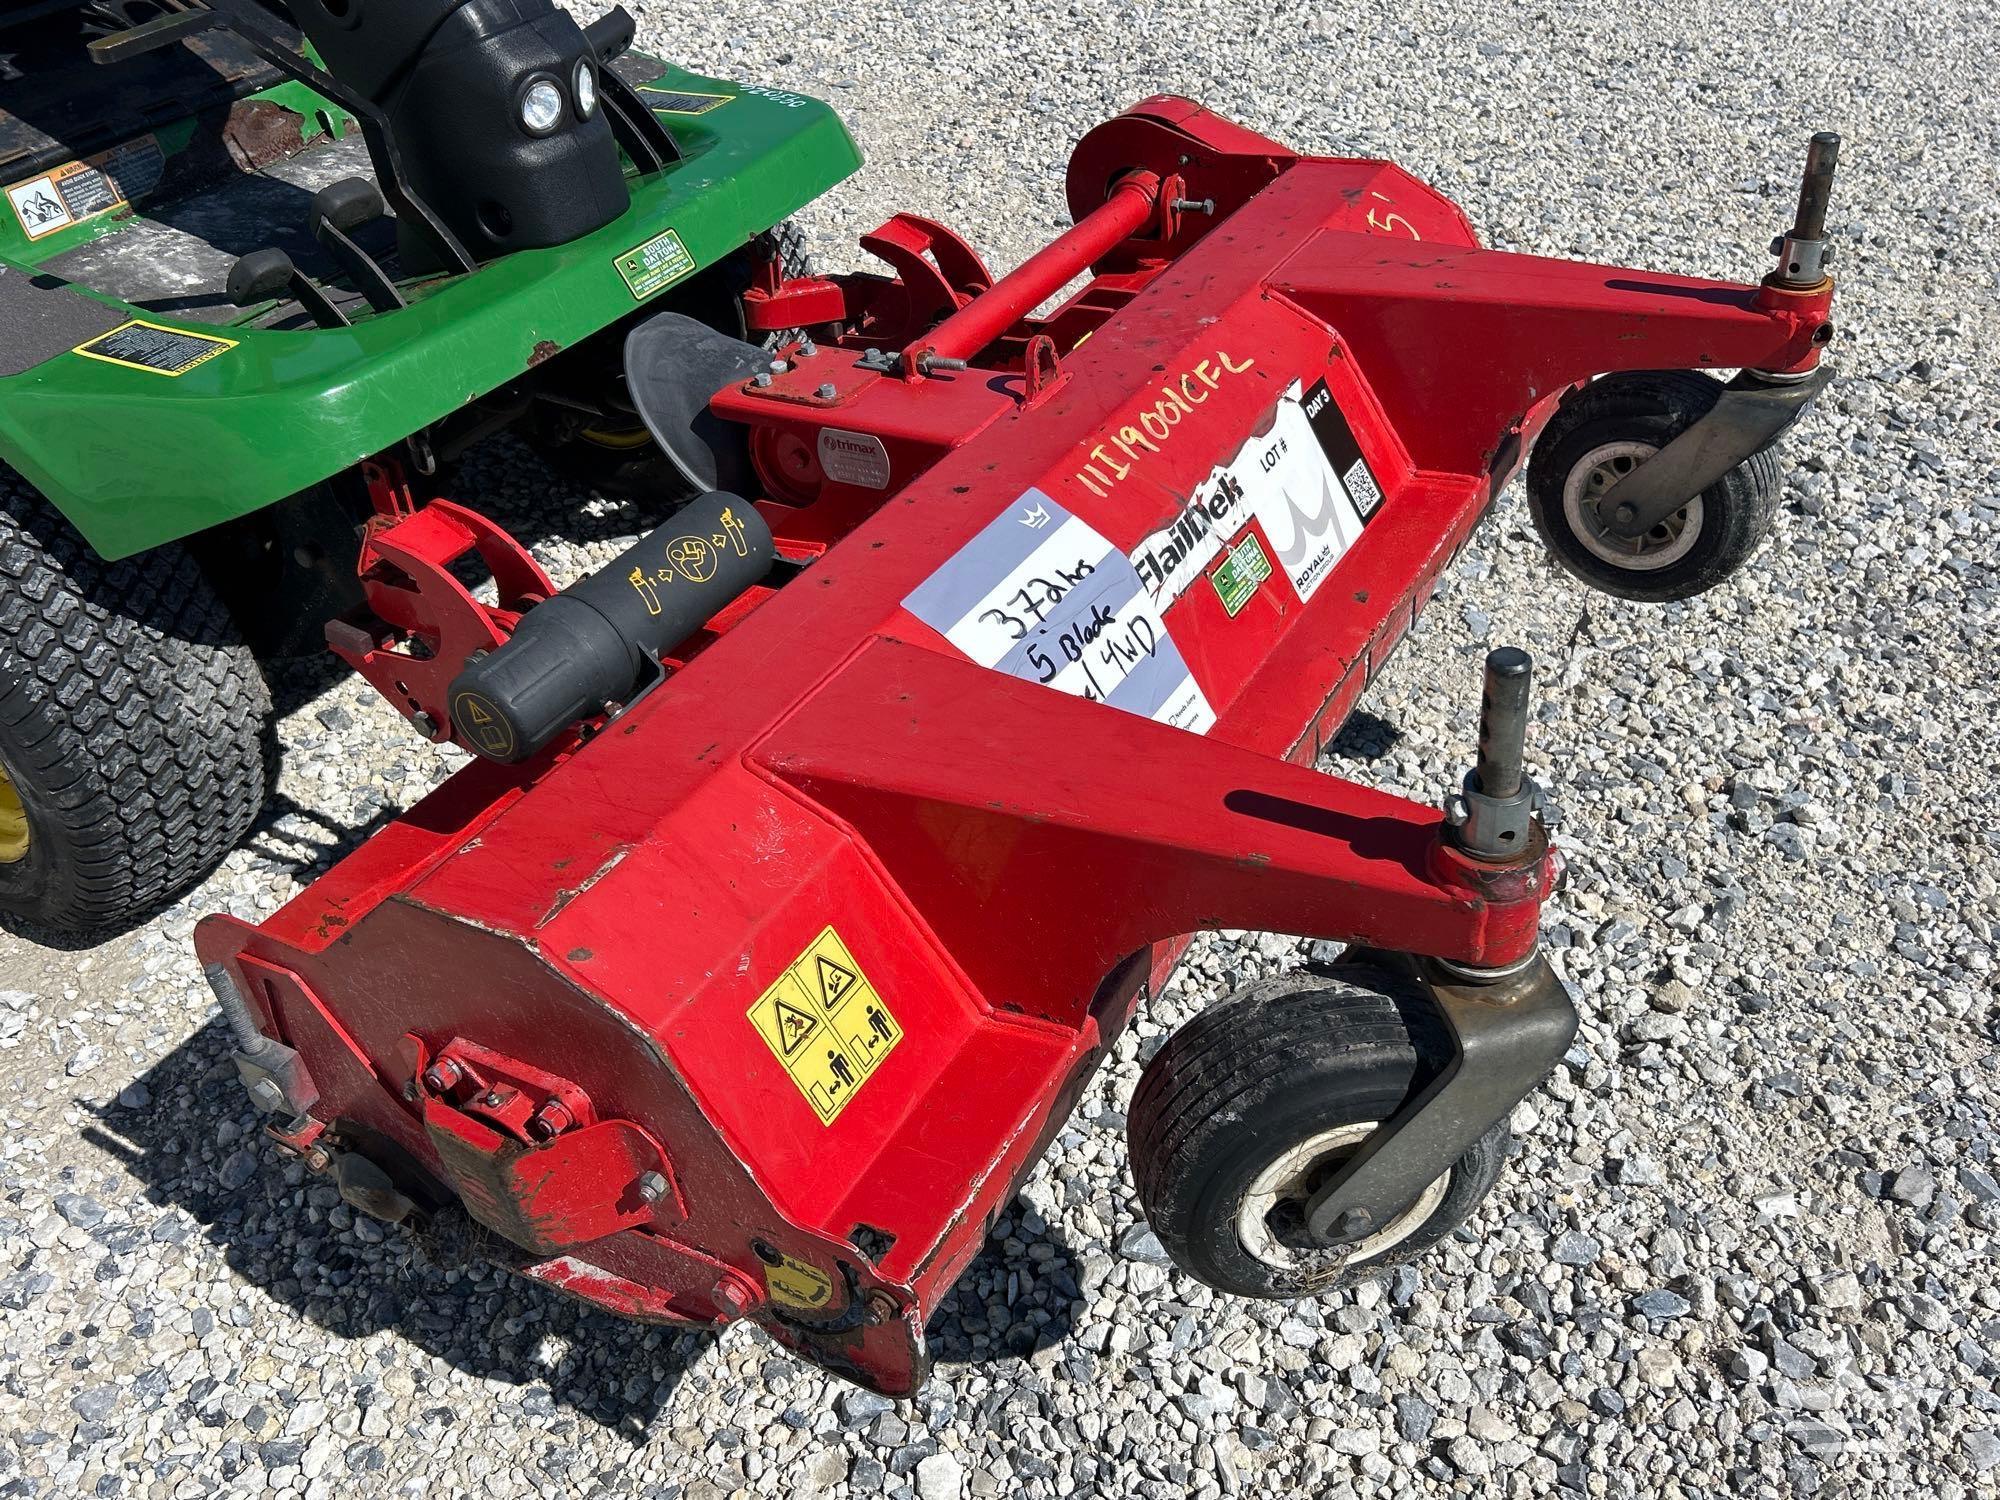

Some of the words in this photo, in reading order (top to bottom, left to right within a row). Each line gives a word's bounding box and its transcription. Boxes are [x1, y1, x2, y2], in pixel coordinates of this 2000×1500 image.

[642, 241, 680, 267] DAYTONA
[643, 237, 670, 256] SOUTH
[1306, 395, 1323, 419] DAY
[1319, 389, 1330, 403] 3
[837, 439, 876, 455] trimax
[1259, 444, 1282, 473] LOT
[1279, 437, 1289, 454] #
[1134, 475, 1245, 595] FlailDek
[1296, 555, 1325, 589] ROYAL
[1100, 615, 1156, 677] 4WD
